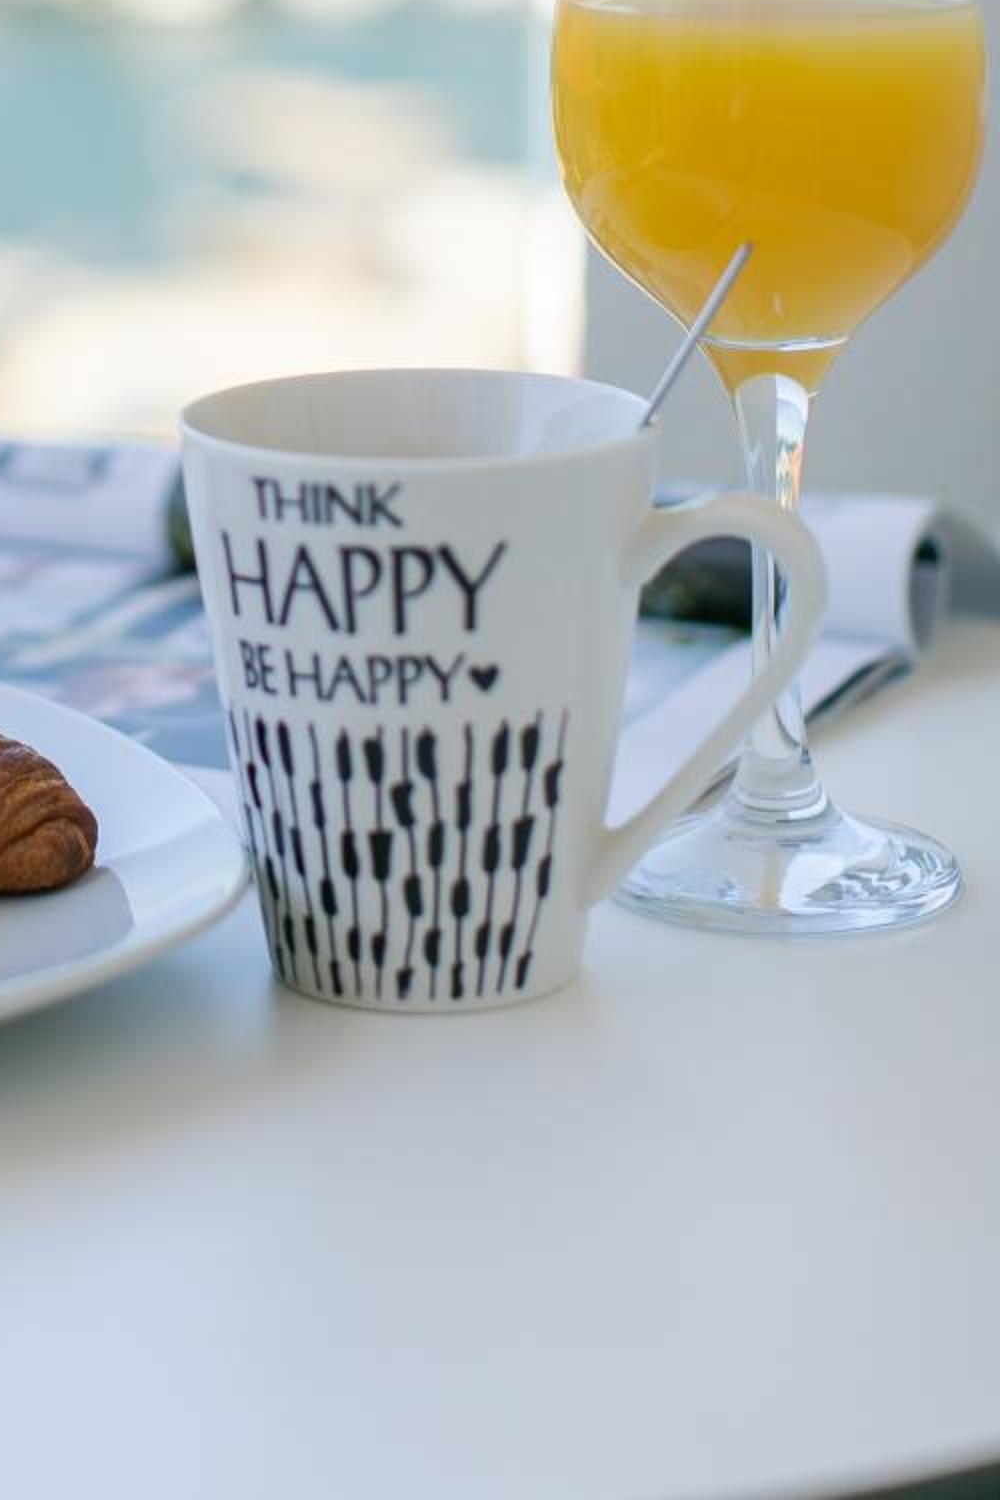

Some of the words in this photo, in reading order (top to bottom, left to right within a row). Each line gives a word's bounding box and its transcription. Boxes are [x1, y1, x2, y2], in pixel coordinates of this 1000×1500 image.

[252, 476, 404, 527] THINK
[221, 530, 508, 635] HAPPY
[239, 639, 278, 695] BE
[285, 649, 466, 705] HAPPY
